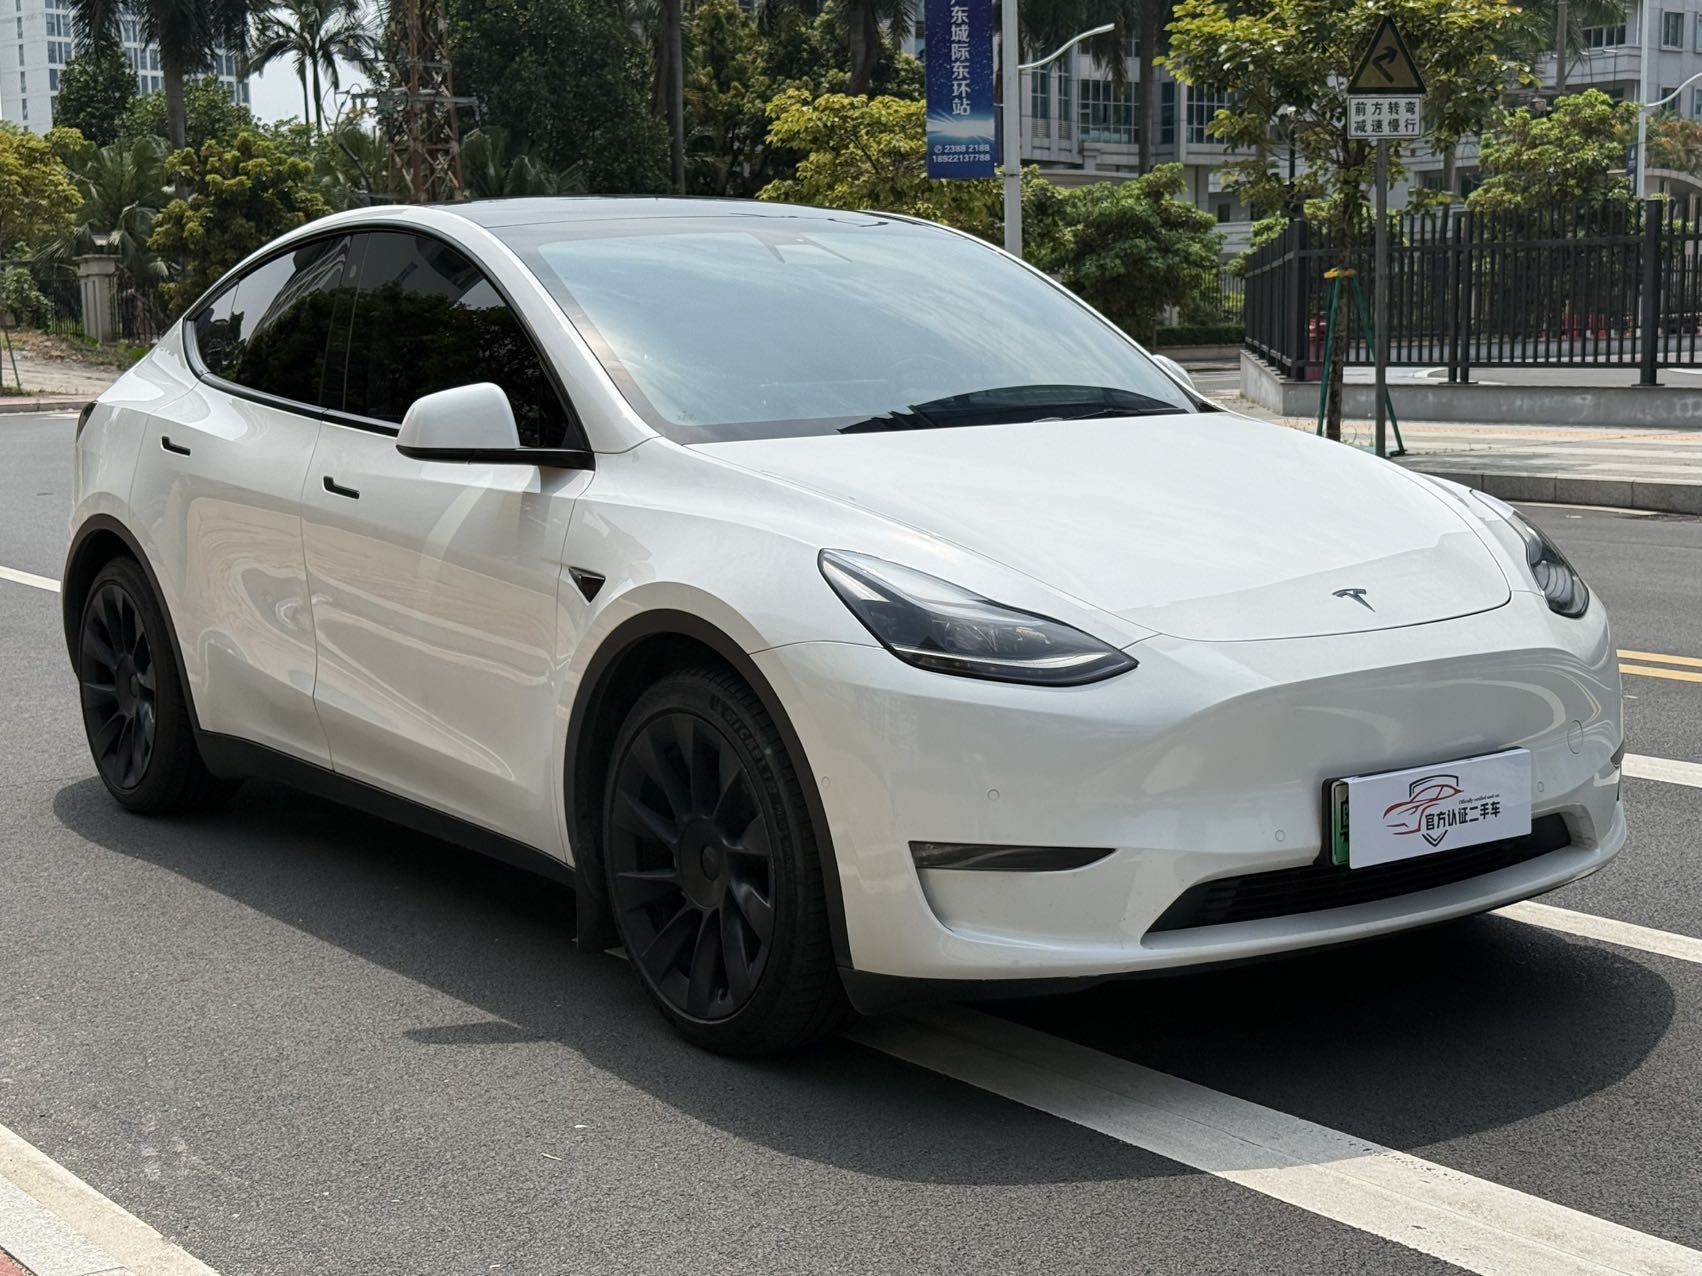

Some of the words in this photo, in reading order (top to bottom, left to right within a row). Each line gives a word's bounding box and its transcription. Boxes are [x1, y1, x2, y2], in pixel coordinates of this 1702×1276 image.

[1354, 101, 1416, 116] 前方转弯
[1354, 118, 1417, 133] 减速慢行
[944, 145, 966, 153] 2388
[968, 144, 990, 152] 2188
[1425, 801, 1500, 831] 官方认证二手车
